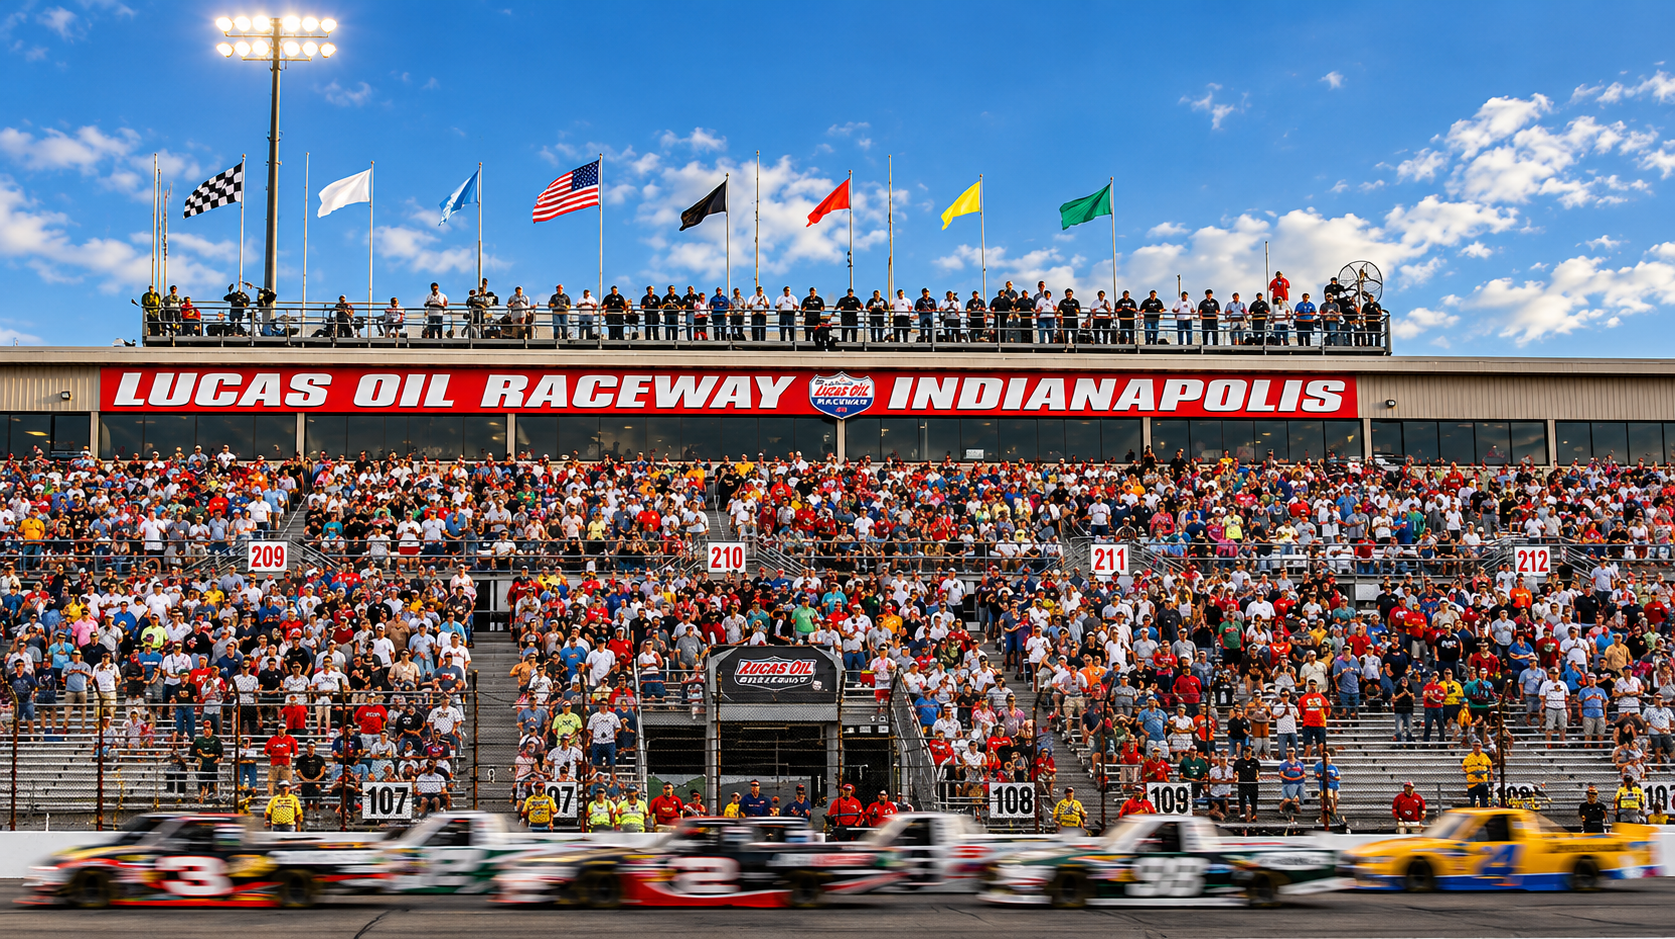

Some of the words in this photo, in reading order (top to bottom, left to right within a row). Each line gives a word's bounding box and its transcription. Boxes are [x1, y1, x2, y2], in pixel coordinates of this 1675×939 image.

[113, 372, 332, 408] LUCAS
[353, 373, 455, 408] OIL
[480, 374, 796, 409] RACEWAY
[886, 376, 1346, 413] INDIANAPOLIS
[251, 545, 285, 568] 209
[711, 546, 743, 569] 210
[1094, 548, 1125, 571] 211
[1517, 549, 1549, 573] 212
[789, 660, 813, 675] OIL
[367, 786, 409, 815] 107
[992, 786, 1033, 814] 108
[1150, 785, 1189, 815] 109
[156, 855, 234, 897] 3
